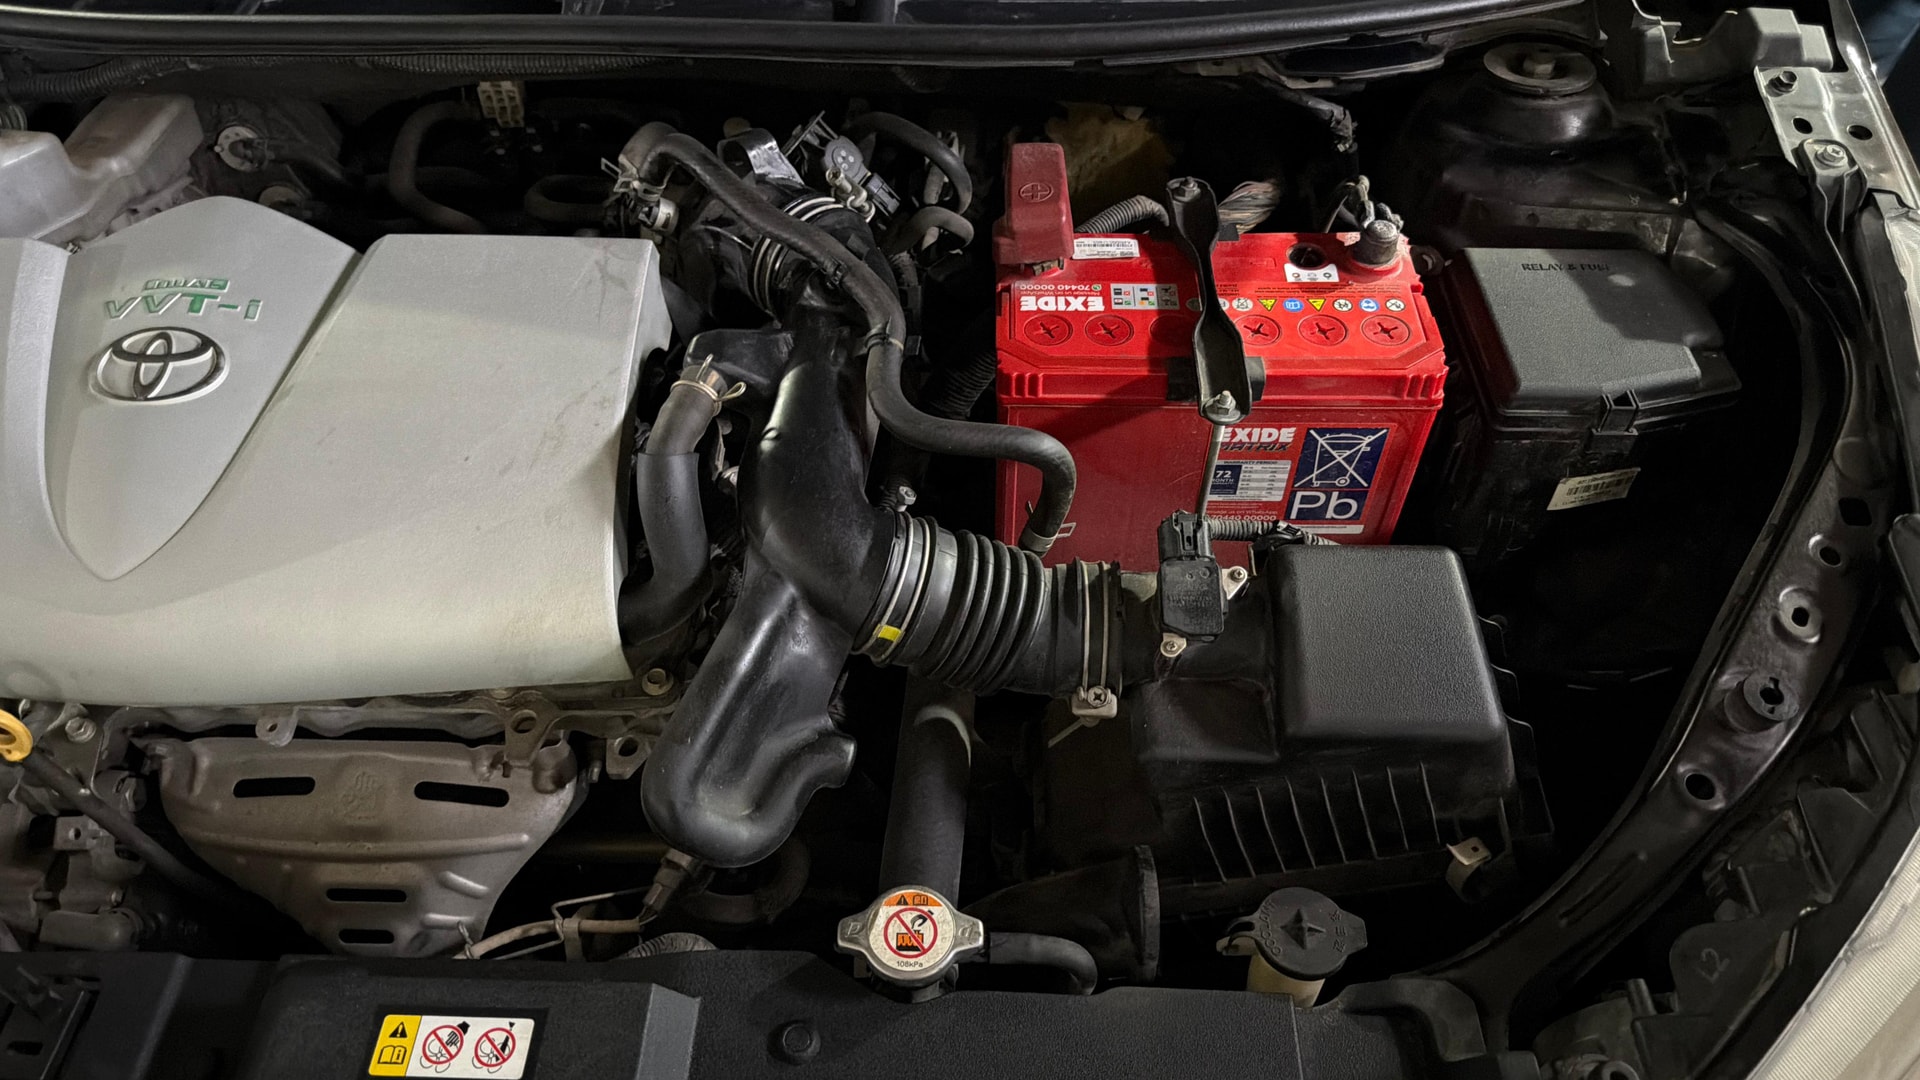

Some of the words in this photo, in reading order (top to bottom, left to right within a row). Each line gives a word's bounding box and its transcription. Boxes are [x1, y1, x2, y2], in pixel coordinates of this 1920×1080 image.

[1520, 263, 1561, 271] RELAY
[143, 278, 230, 292] DUAL
[105, 292, 263, 322] VVT-i
[1020, 296, 1105, 311] EXIDE
[1215, 470, 1232, 478] 72
[1290, 491, 1358, 520] Pb
[896, 960, 924, 968] 108kPa
